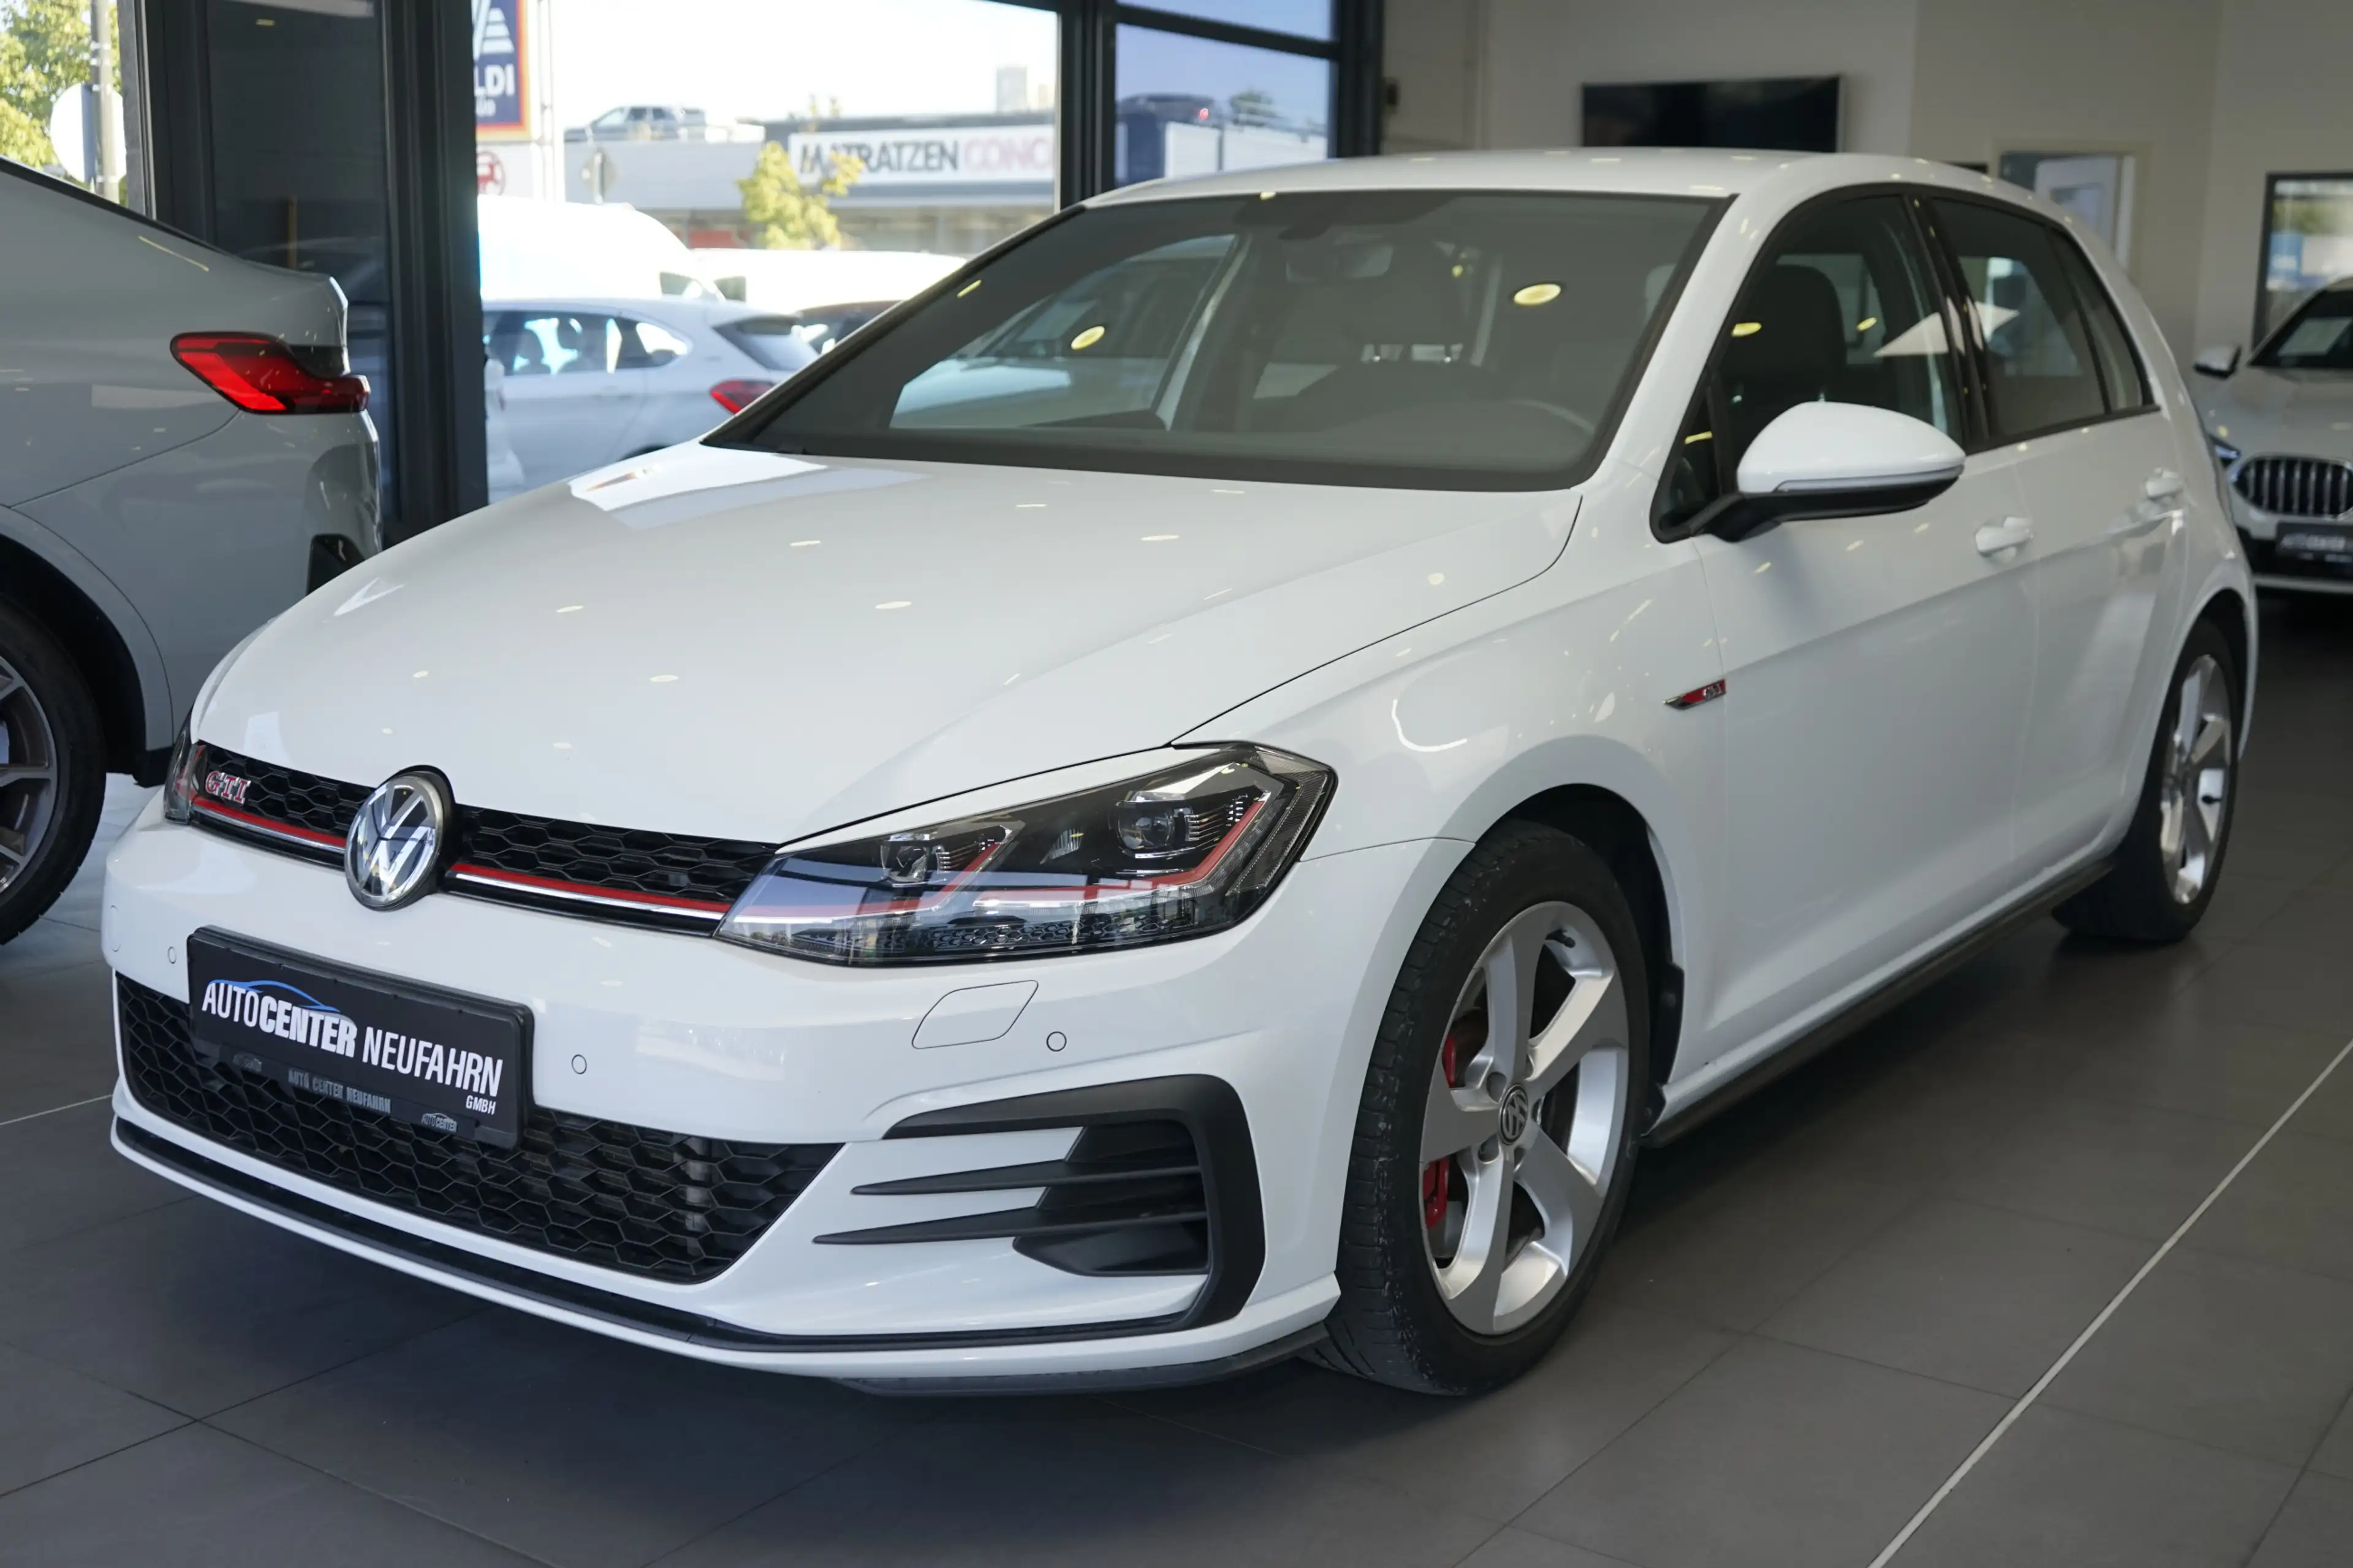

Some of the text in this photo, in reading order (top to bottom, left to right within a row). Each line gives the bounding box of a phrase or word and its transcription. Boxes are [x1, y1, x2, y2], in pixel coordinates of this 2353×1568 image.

[206, 771, 251, 804] GTI
[202, 982, 503, 1097] AUTOCENTER NEUFAHRN
[288, 1069, 391, 1114] AUTO CENTER NEUFAHRN
[466, 1095, 496, 1115] GMBH
[421, 1113, 457, 1133] AUTOCENTER
